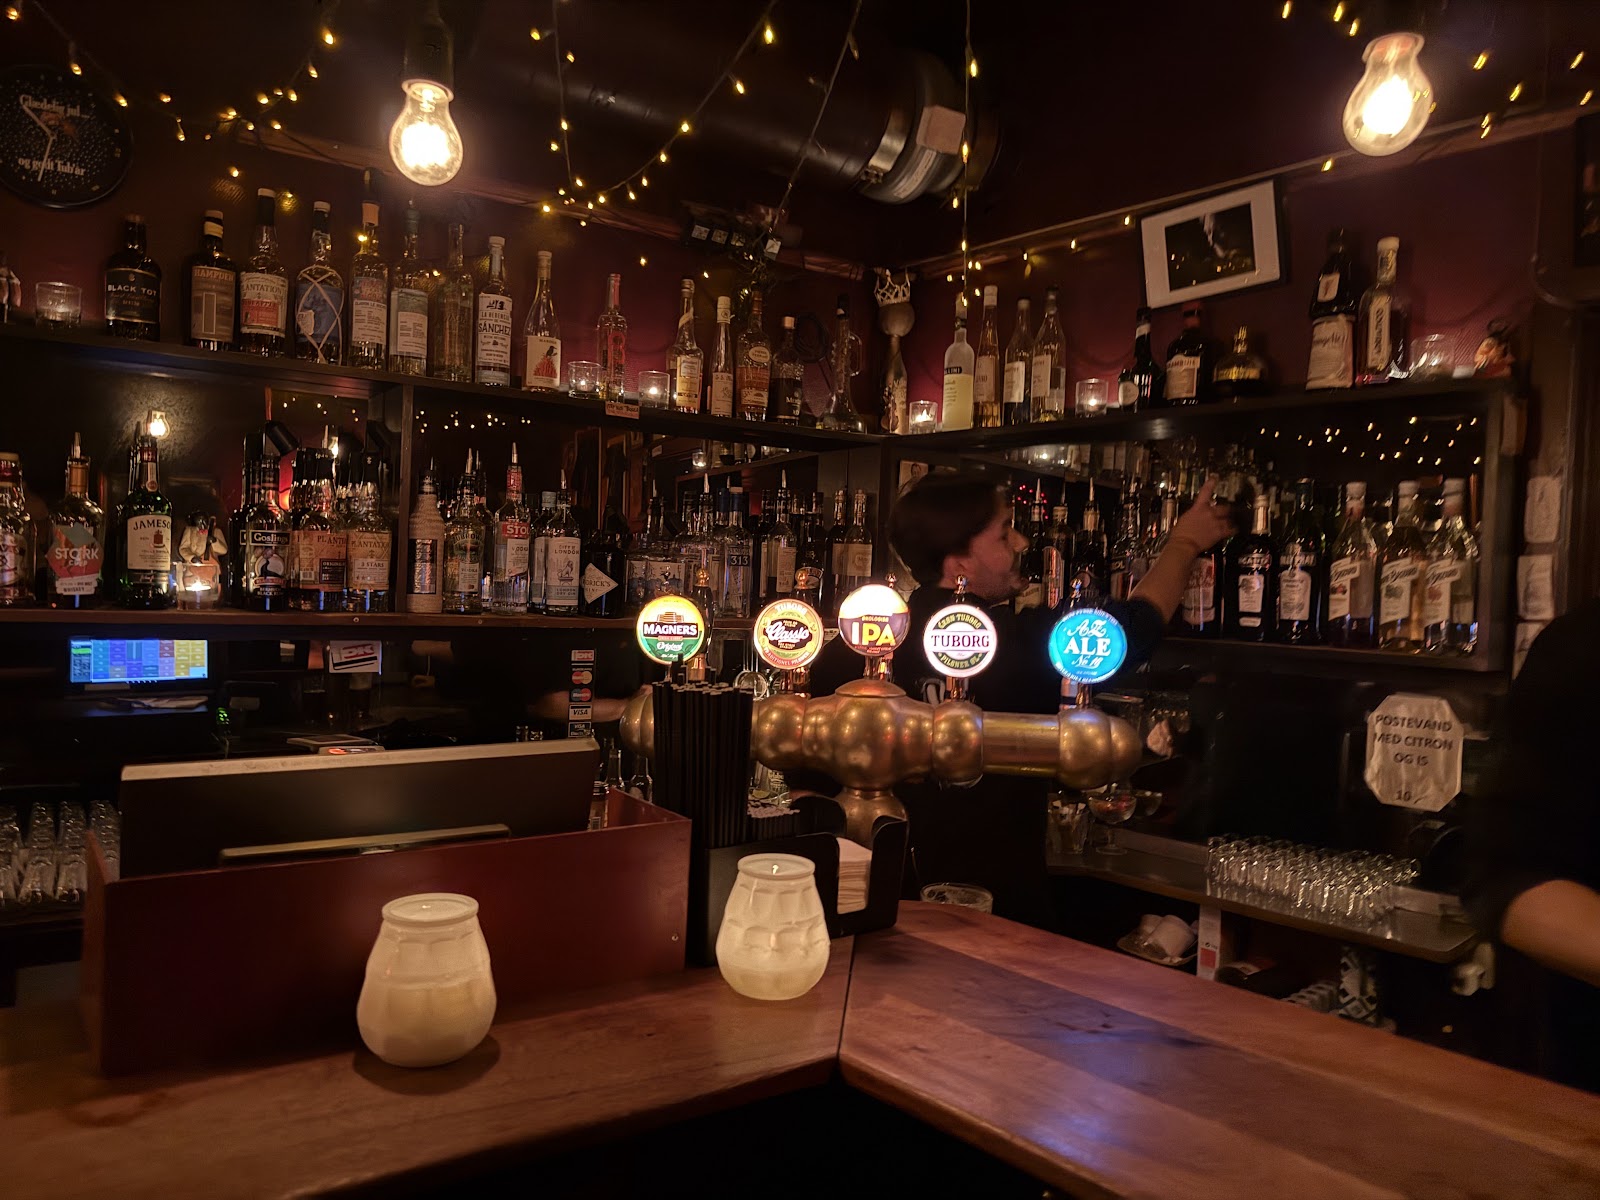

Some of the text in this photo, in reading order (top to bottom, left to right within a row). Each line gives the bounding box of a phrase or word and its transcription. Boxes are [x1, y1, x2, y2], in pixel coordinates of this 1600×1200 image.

[194, 268, 234, 281] HAMPDEN
[107, 284, 137, 293] BLACK
[140, 287, 157, 297] TOT
[478, 320, 511, 336] SÁNCHEZ
[55, 547, 99, 560] STORK
[730, 555, 749, 565] 313
[643, 623, 698, 636] MAGNERS
[765, 621, 810, 641] Classic
[851, 621, 897, 647] IPA
[930, 634, 990, 648] TUBORG
[1063, 636, 1112, 657] ALE
[1375, 714, 1453, 732] POSTEVAND
[1404, 735, 1453, 750] CITRON
[1393, 752, 1429, 766] OG IS
